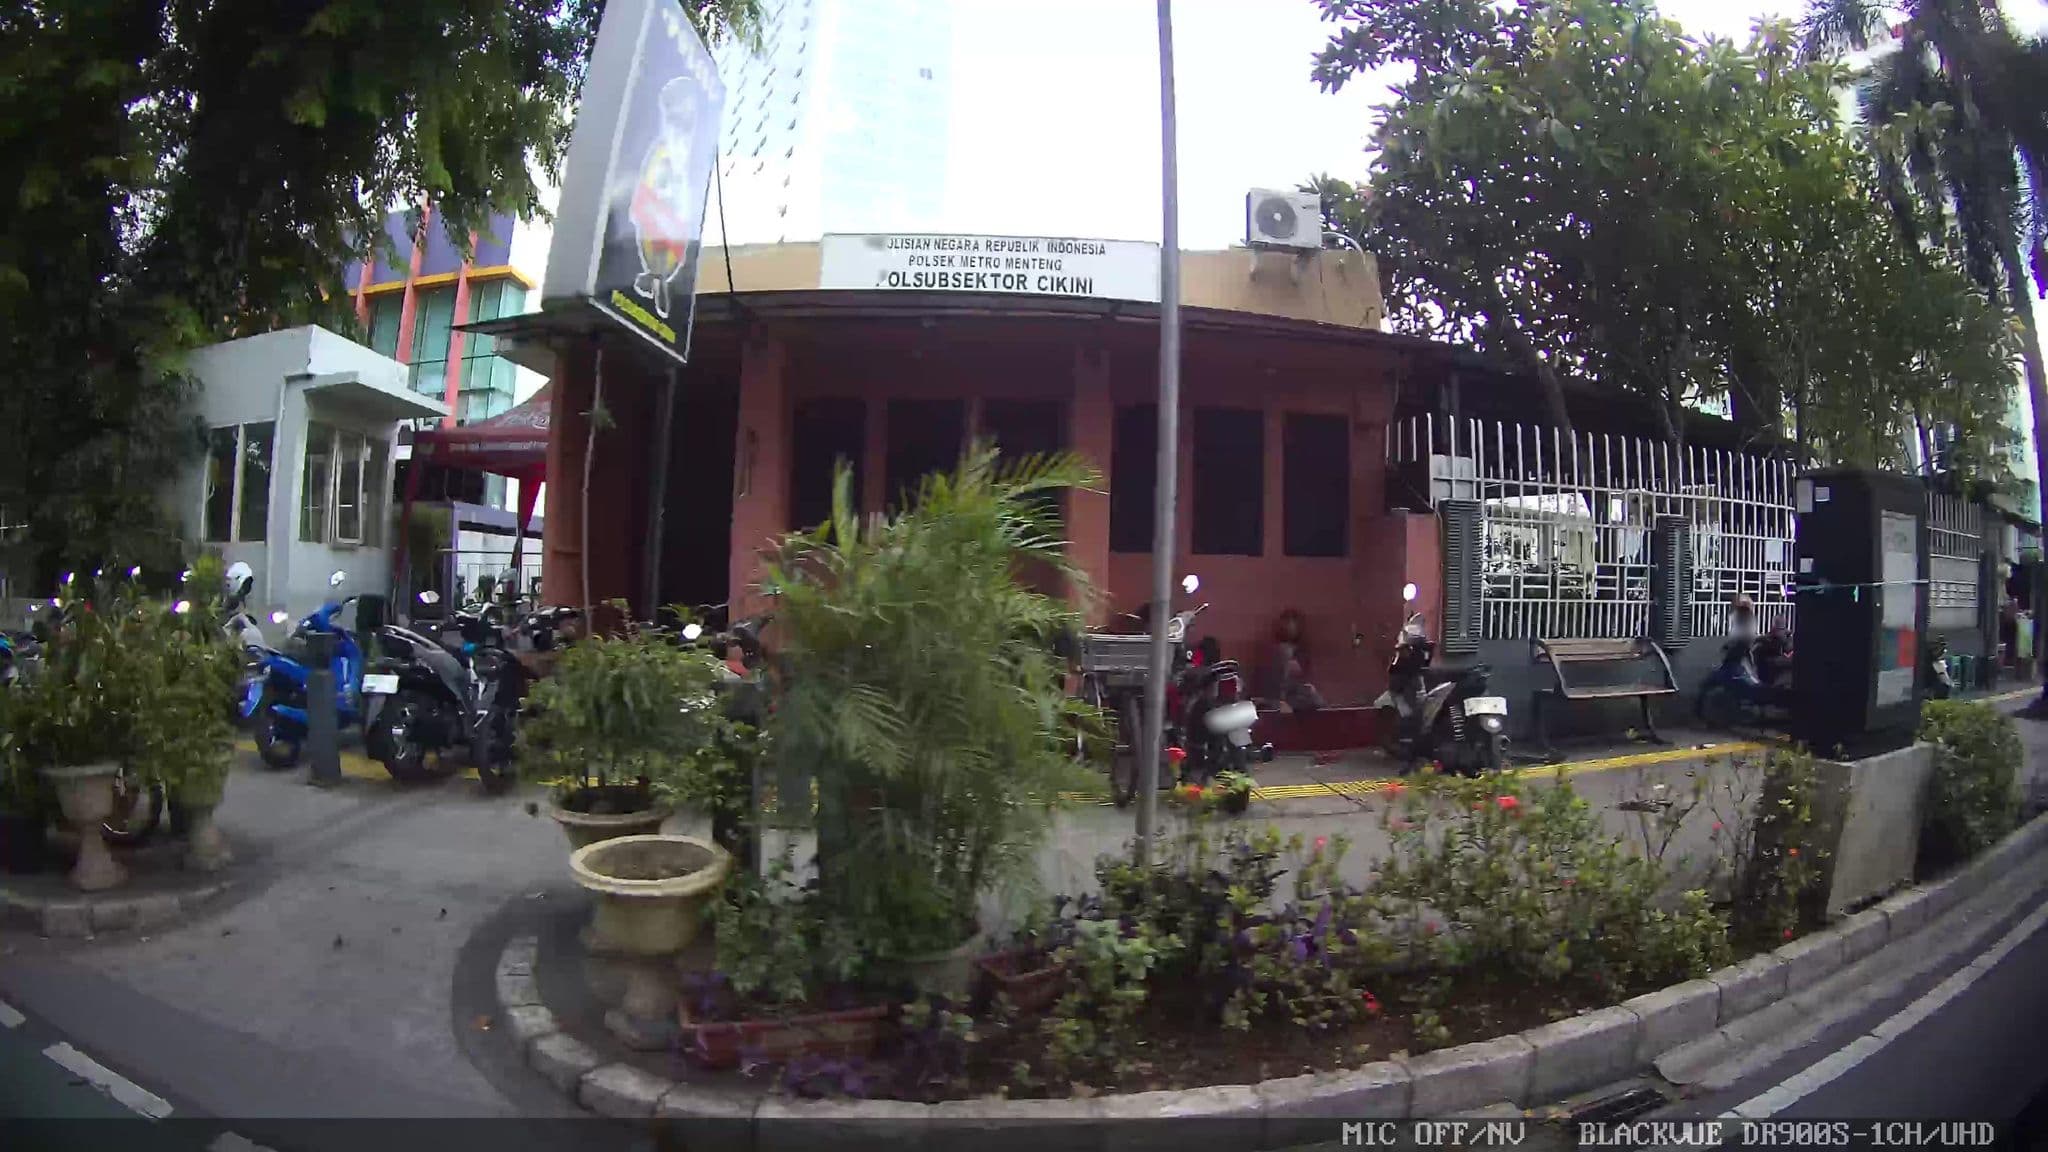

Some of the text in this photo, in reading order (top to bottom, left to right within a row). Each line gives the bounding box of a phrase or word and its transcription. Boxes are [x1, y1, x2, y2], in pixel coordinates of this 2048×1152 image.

[933, 239, 980, 252] NEGARA
[985, 240, 1040, 253] REPUBLIK
[1047, 242, 1106, 256] INDONESIA
[908, 254, 1063, 271] POLSEK METRO MENTENG
[876, 271, 1094, 294] OLSUBSEKTOR CIKINI
